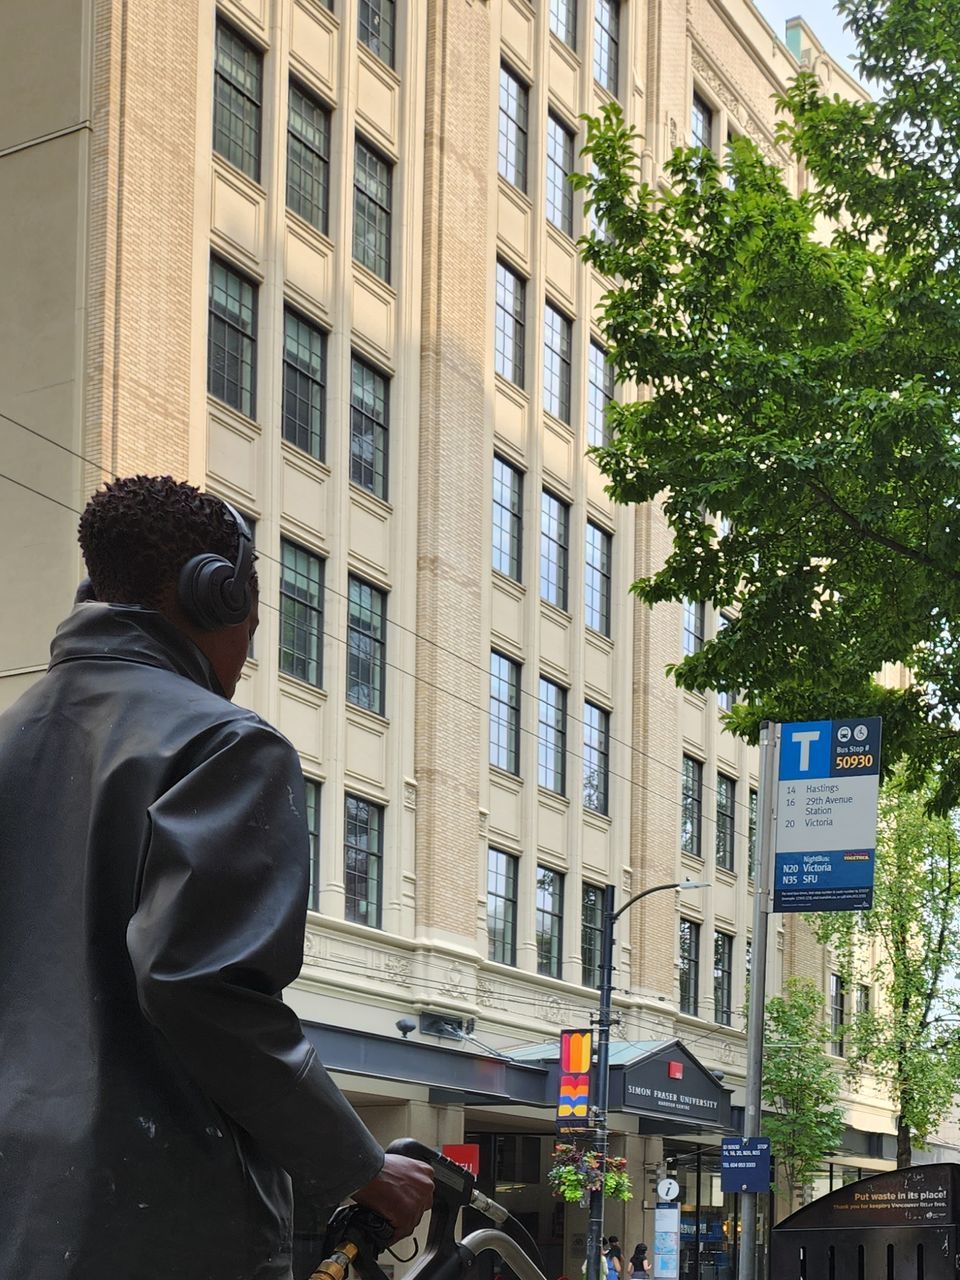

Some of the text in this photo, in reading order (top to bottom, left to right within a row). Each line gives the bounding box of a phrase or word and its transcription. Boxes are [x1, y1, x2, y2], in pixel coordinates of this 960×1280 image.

[792, 731, 820, 772] T
[836, 746, 848, 754] Bus
[836, 754, 873, 769] 50930
[787, 784, 840, 794] 14 Hastings
[786, 796, 853, 806] 16 29th Avenue
[805, 806, 832, 815] Station
[785, 818, 833, 828] 20 Victoria
[783, 863, 832, 873] N20 Victoria
[782, 875, 818, 884] N35 SFU
[628, 1085, 717, 1109] SIMON FRASER UNIVERSITY
[871, 1192, 896, 1200] waste
[898, 1191, 906, 1199] in
[908, 1191, 919, 1199] its
[920, 1190, 947, 1200] place!
